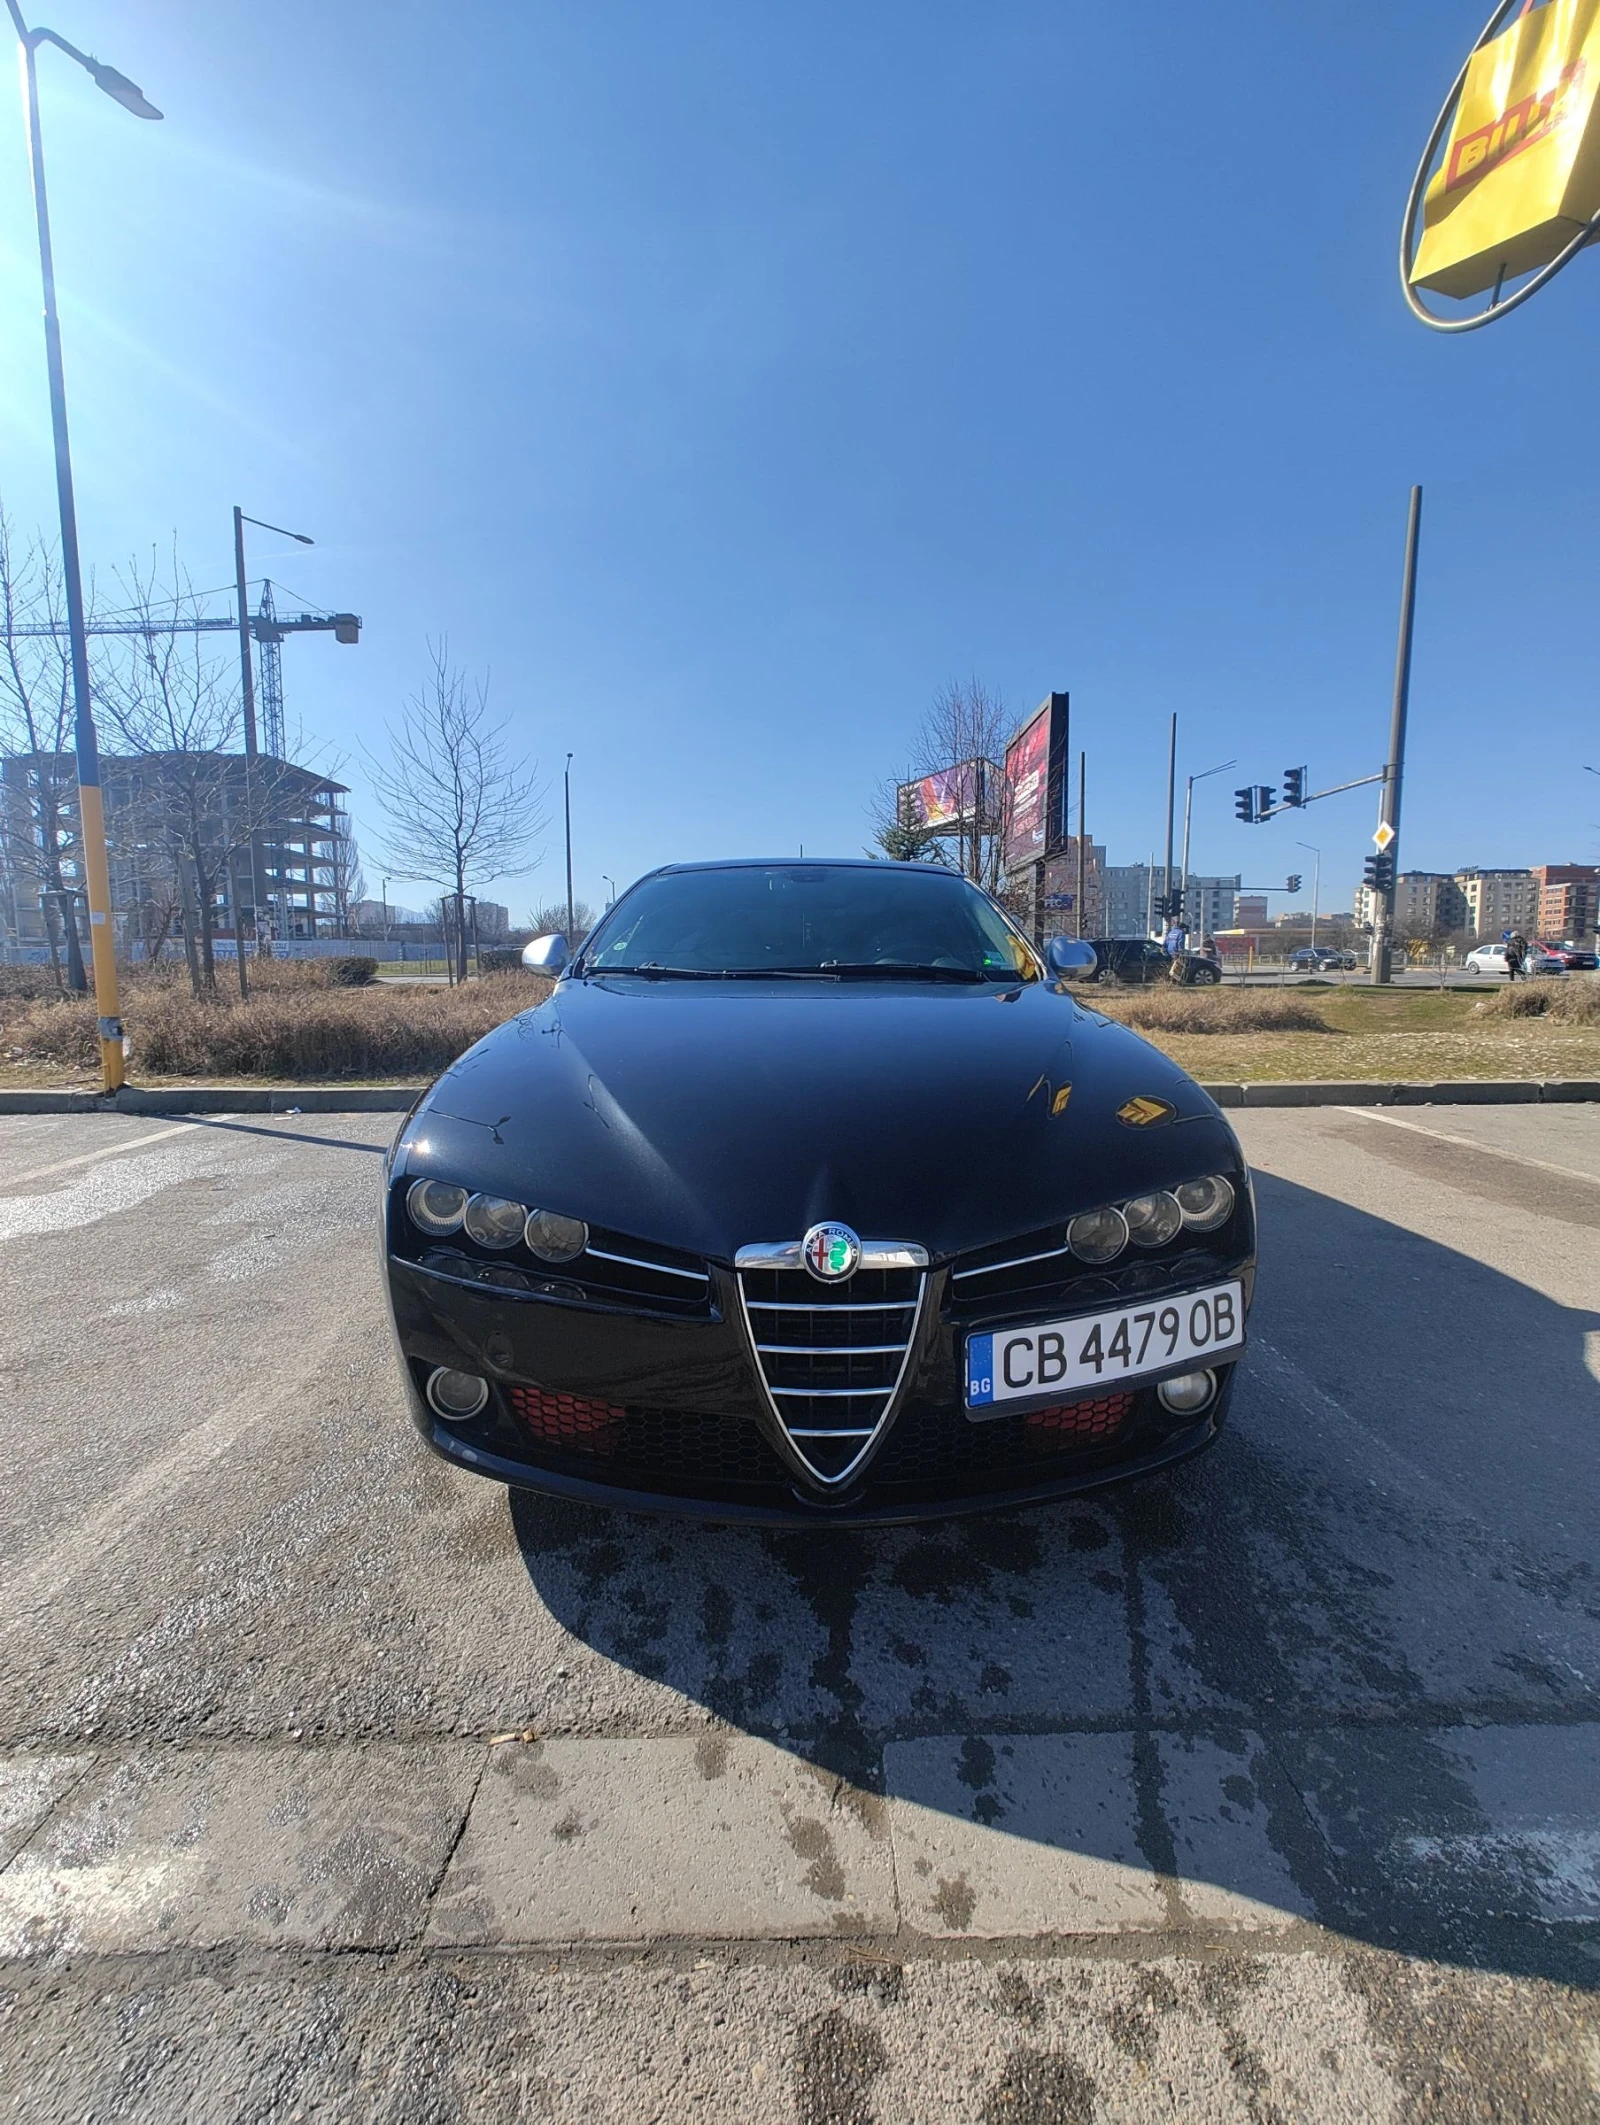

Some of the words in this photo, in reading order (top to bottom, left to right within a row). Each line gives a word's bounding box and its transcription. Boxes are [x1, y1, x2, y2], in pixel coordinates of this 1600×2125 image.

[806, 1231, 826, 1254] ALFA
[829, 1228, 858, 1257] ROMEO
[1003, 1331, 1068, 1388] CB
[1079, 1306, 1180, 1374] 4479
[970, 1377, 991, 1396] BG
